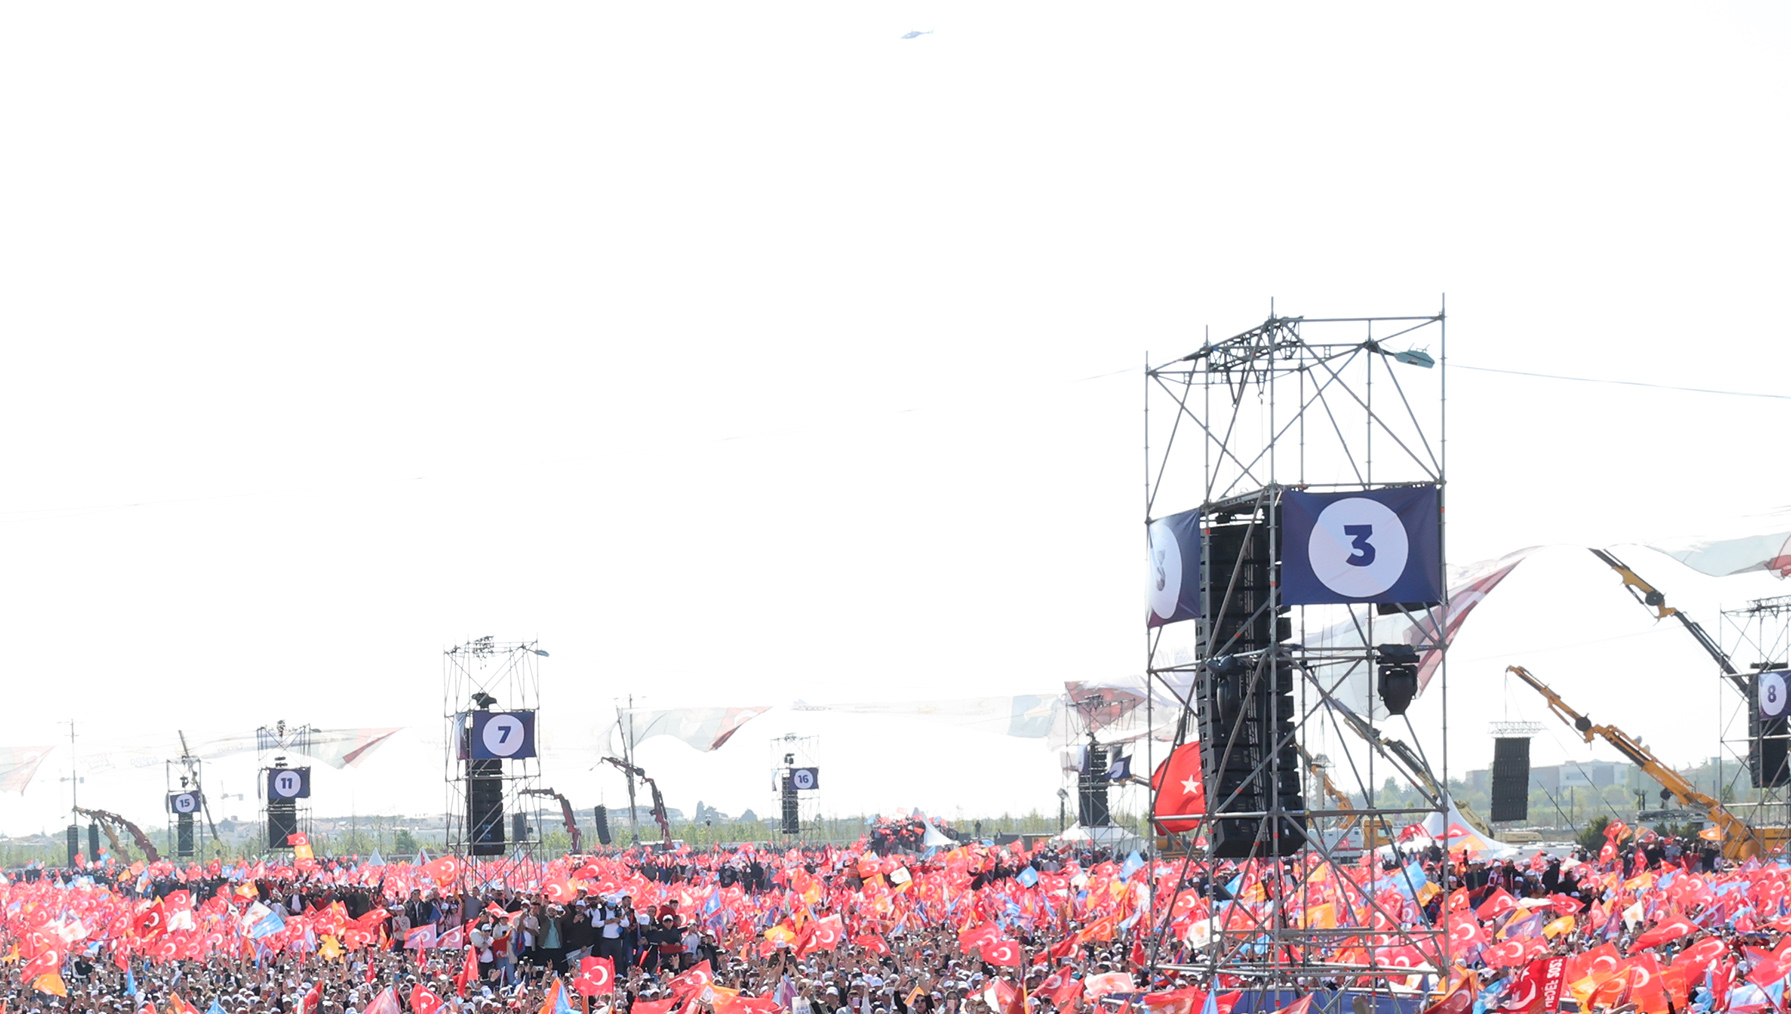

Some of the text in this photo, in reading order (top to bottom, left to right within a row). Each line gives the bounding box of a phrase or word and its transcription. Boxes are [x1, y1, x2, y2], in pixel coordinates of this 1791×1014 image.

[1343, 524, 1376, 566] 3
[1767, 684, 1777, 704] 8
[497, 726, 512, 744] 7
[280, 778, 294, 790] 11
[797, 775, 809, 784] 16
[179, 799, 191, 807] 15
